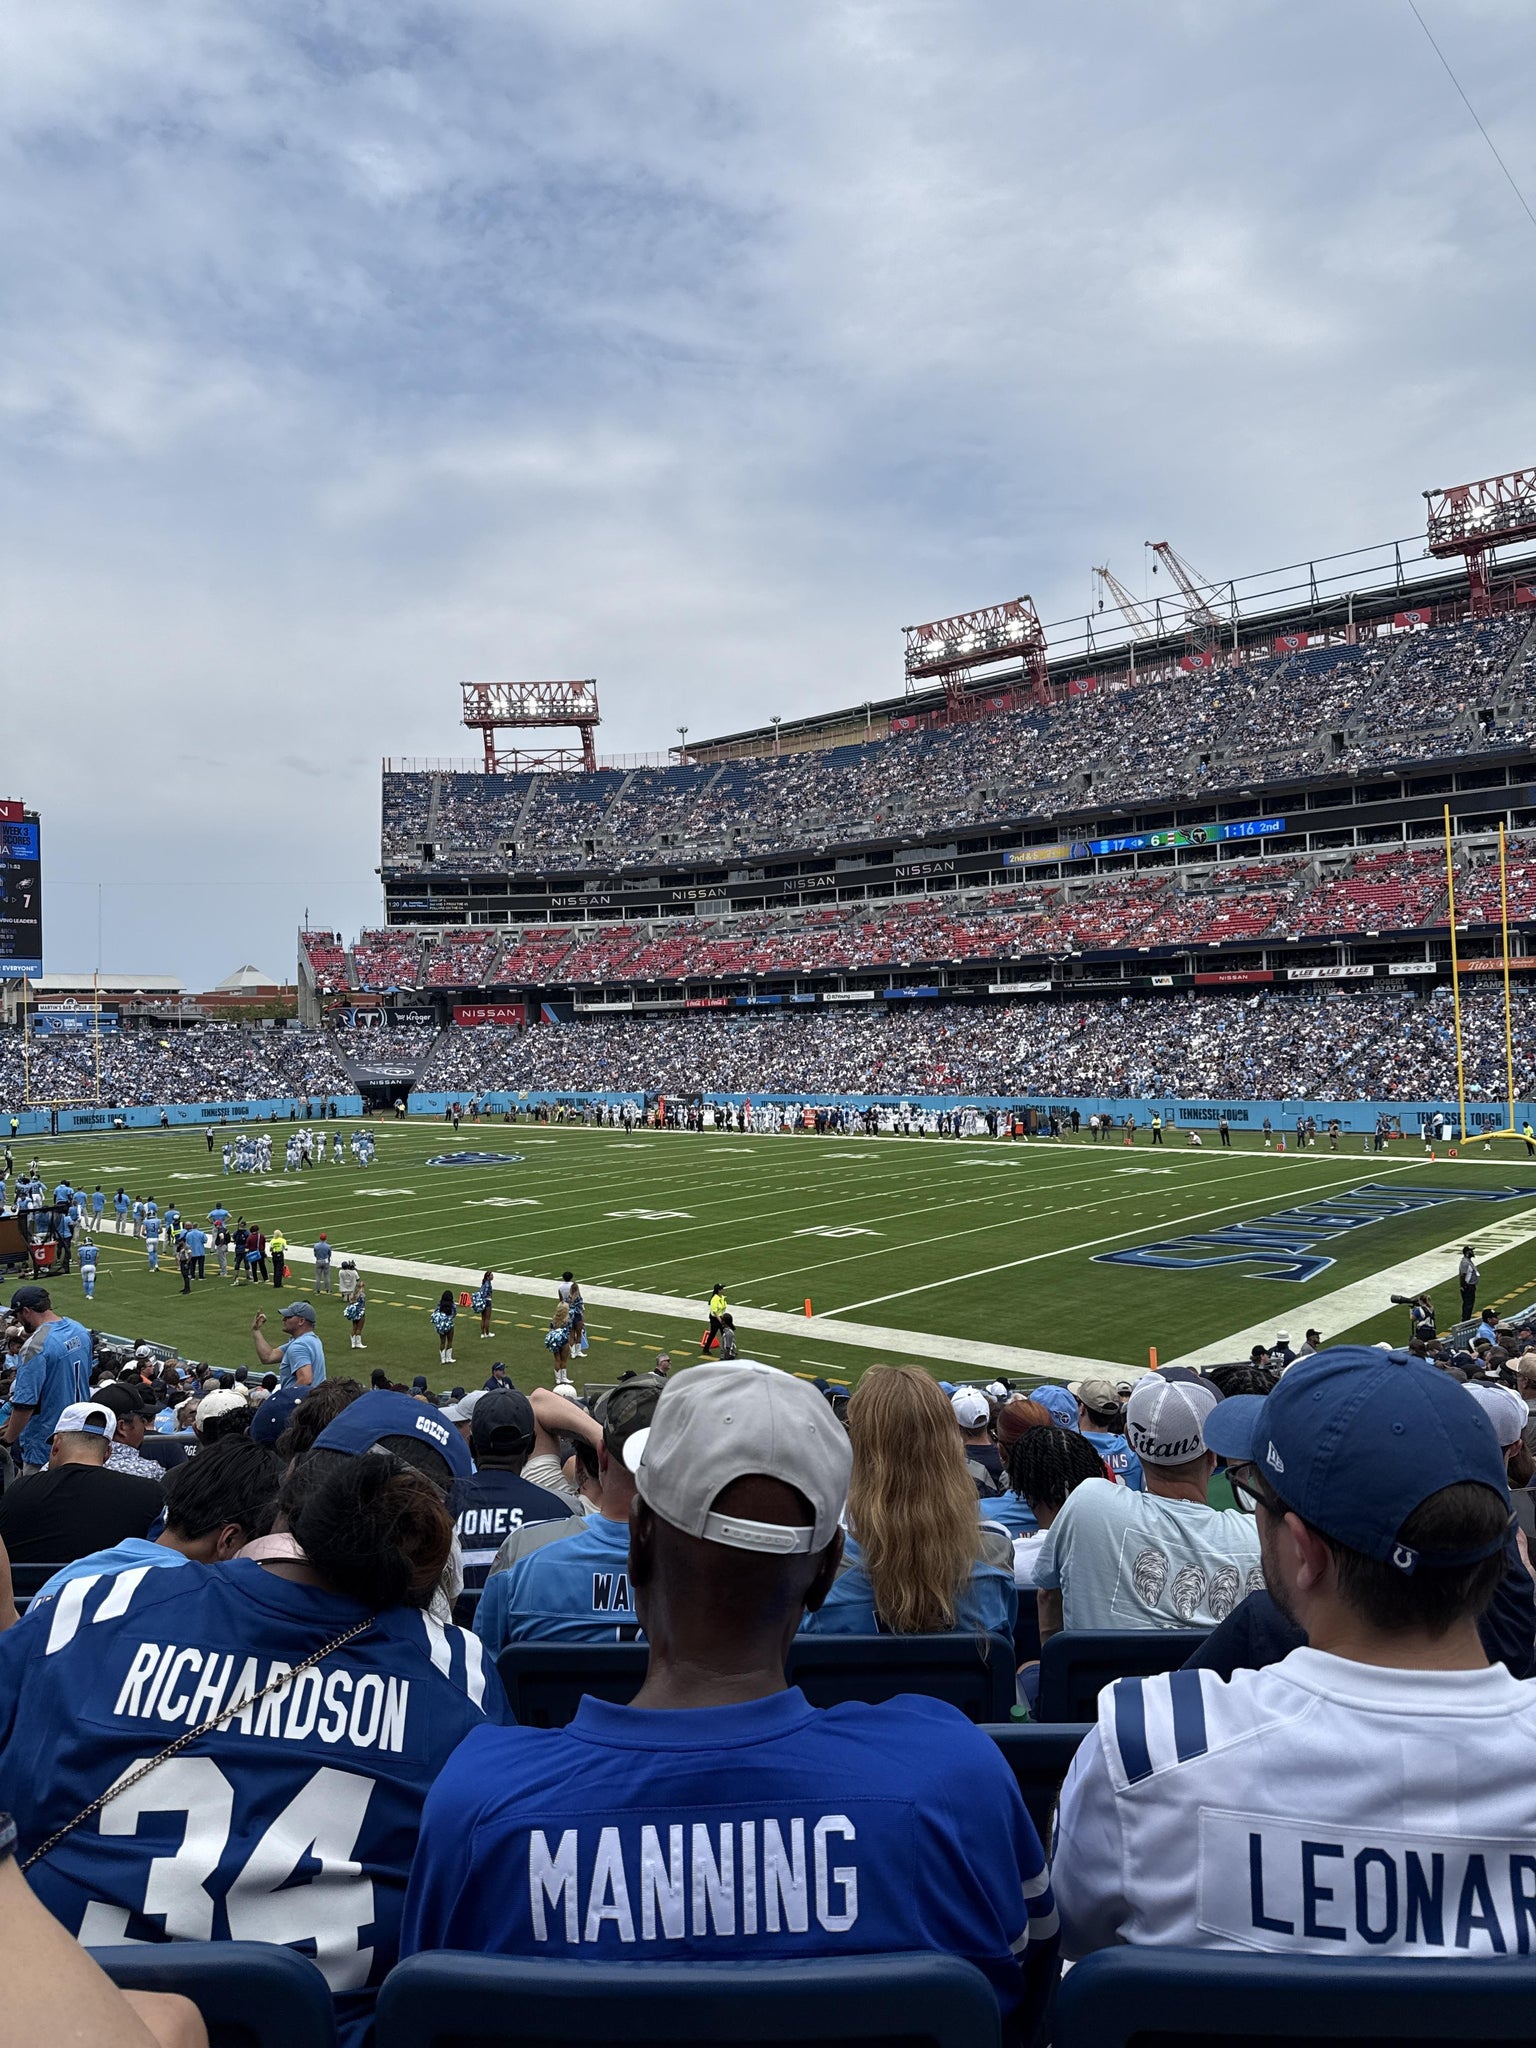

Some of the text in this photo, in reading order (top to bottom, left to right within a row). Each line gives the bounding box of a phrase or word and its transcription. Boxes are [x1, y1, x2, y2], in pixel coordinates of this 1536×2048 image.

[3, 826, 21, 836] WEEK
[1224, 821, 1280, 838] 1:16 2nd
[3, 835, 31, 846] SCORES
[1113, 839, 1126, 851] 17
[1150, 835, 1160, 846] 6
[1009, 853, 1024, 863] 2nd
[896, 861, 955, 877] NISSAN
[784, 875, 835, 890] NISSAN
[672, 887, 727, 900] NISSAN
[23, 894, 31, 908] 7
[552, 895, 610, 906] NISSAN
[1468, 961, 1495, 970] Tito's
[1476, 973, 1499, 981] EARL
[406, 1011, 431, 1025] Kroger
[462, 1009, 516, 1018] NISSAN
[201, 1106, 250, 1118] TENNESSEE TOUGH
[1179, 1108, 1249, 1121] TENNESSEE TOUGH
[73, 1115, 106, 1125] TENNESSEE
[1470, 1113, 1502, 1126] TOUGH
[603, 1208, 690, 1220] 20
[150, 1222, 156, 1233] 3
[792, 1225, 876, 1237] 10
[34, 1248, 46, 1260] G
[460, 1293, 468, 1306] 10
[74, 1361, 81, 1404] 1
[416, 1415, 450, 1445] COLTS
[1130, 1421, 1200, 1458] Titans
[592, 1573, 636, 1612] WA
[113, 1642, 409, 1753] RICHARDSON
[78, 1757, 375, 1992] 34
[529, 1815, 858, 1944] MANNING
